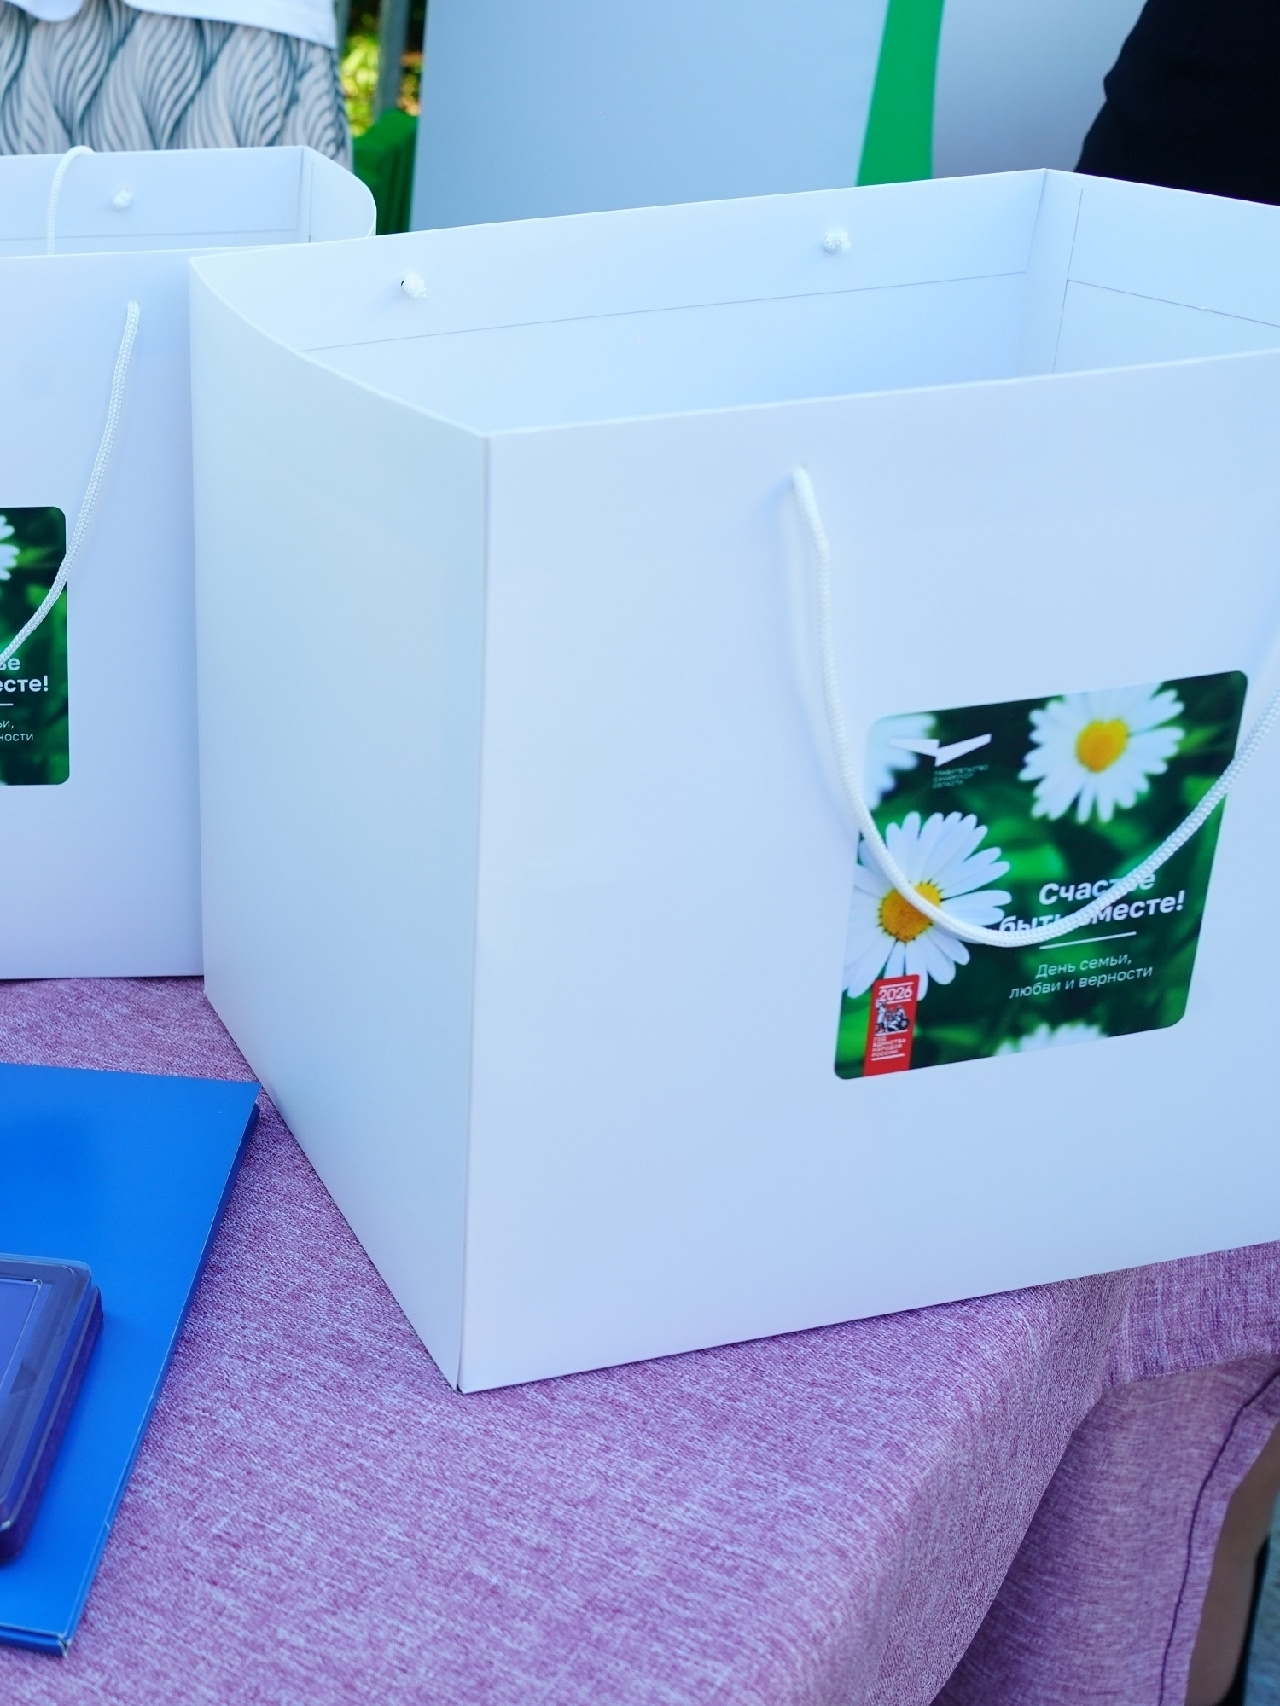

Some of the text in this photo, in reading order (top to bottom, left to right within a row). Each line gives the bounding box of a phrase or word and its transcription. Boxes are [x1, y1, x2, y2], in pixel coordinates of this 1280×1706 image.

[1078, 890, 1185, 926] месте!
[1035, 953, 1132, 979] День семьи,
[878, 985, 913, 1002] 2026
[1008, 966, 1154, 999] любви и верности
